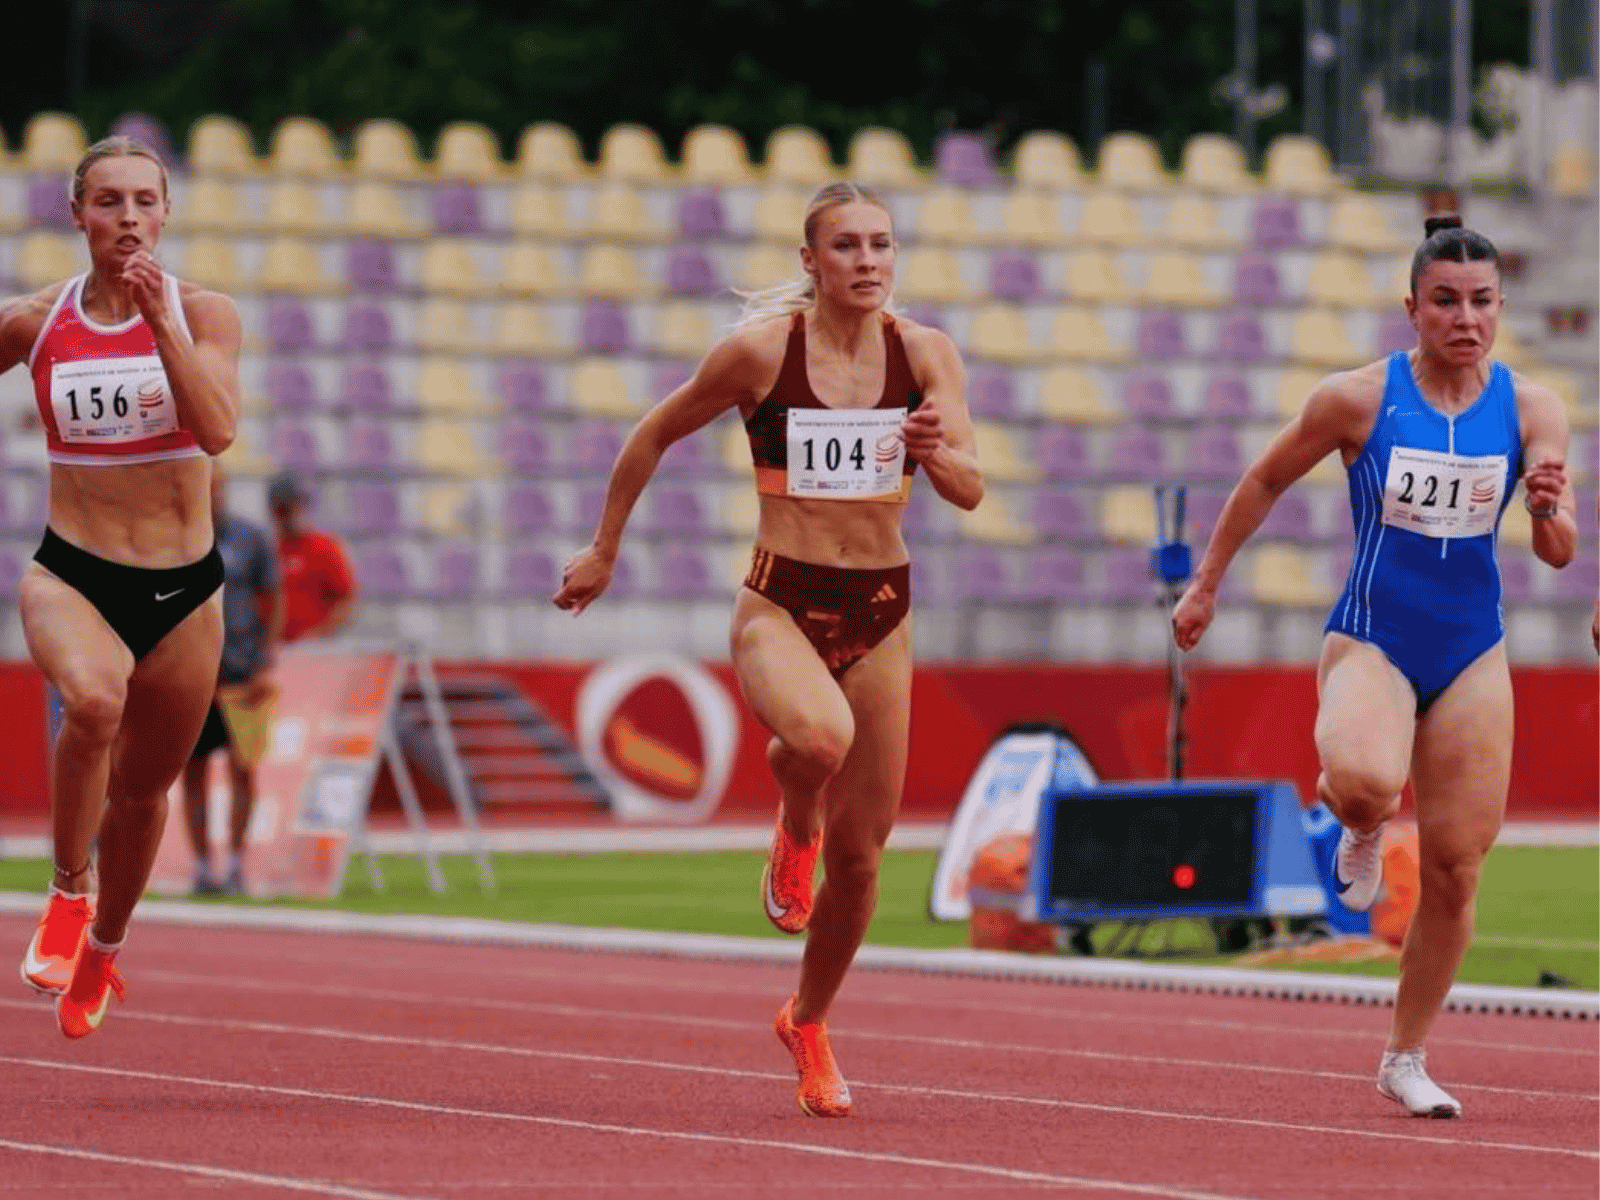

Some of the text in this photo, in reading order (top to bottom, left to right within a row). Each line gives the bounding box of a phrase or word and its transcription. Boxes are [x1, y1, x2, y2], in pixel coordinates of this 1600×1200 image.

[66, 384, 128, 420] 156
[803, 438, 865, 471] 104
[1398, 472, 1460, 509] 221
